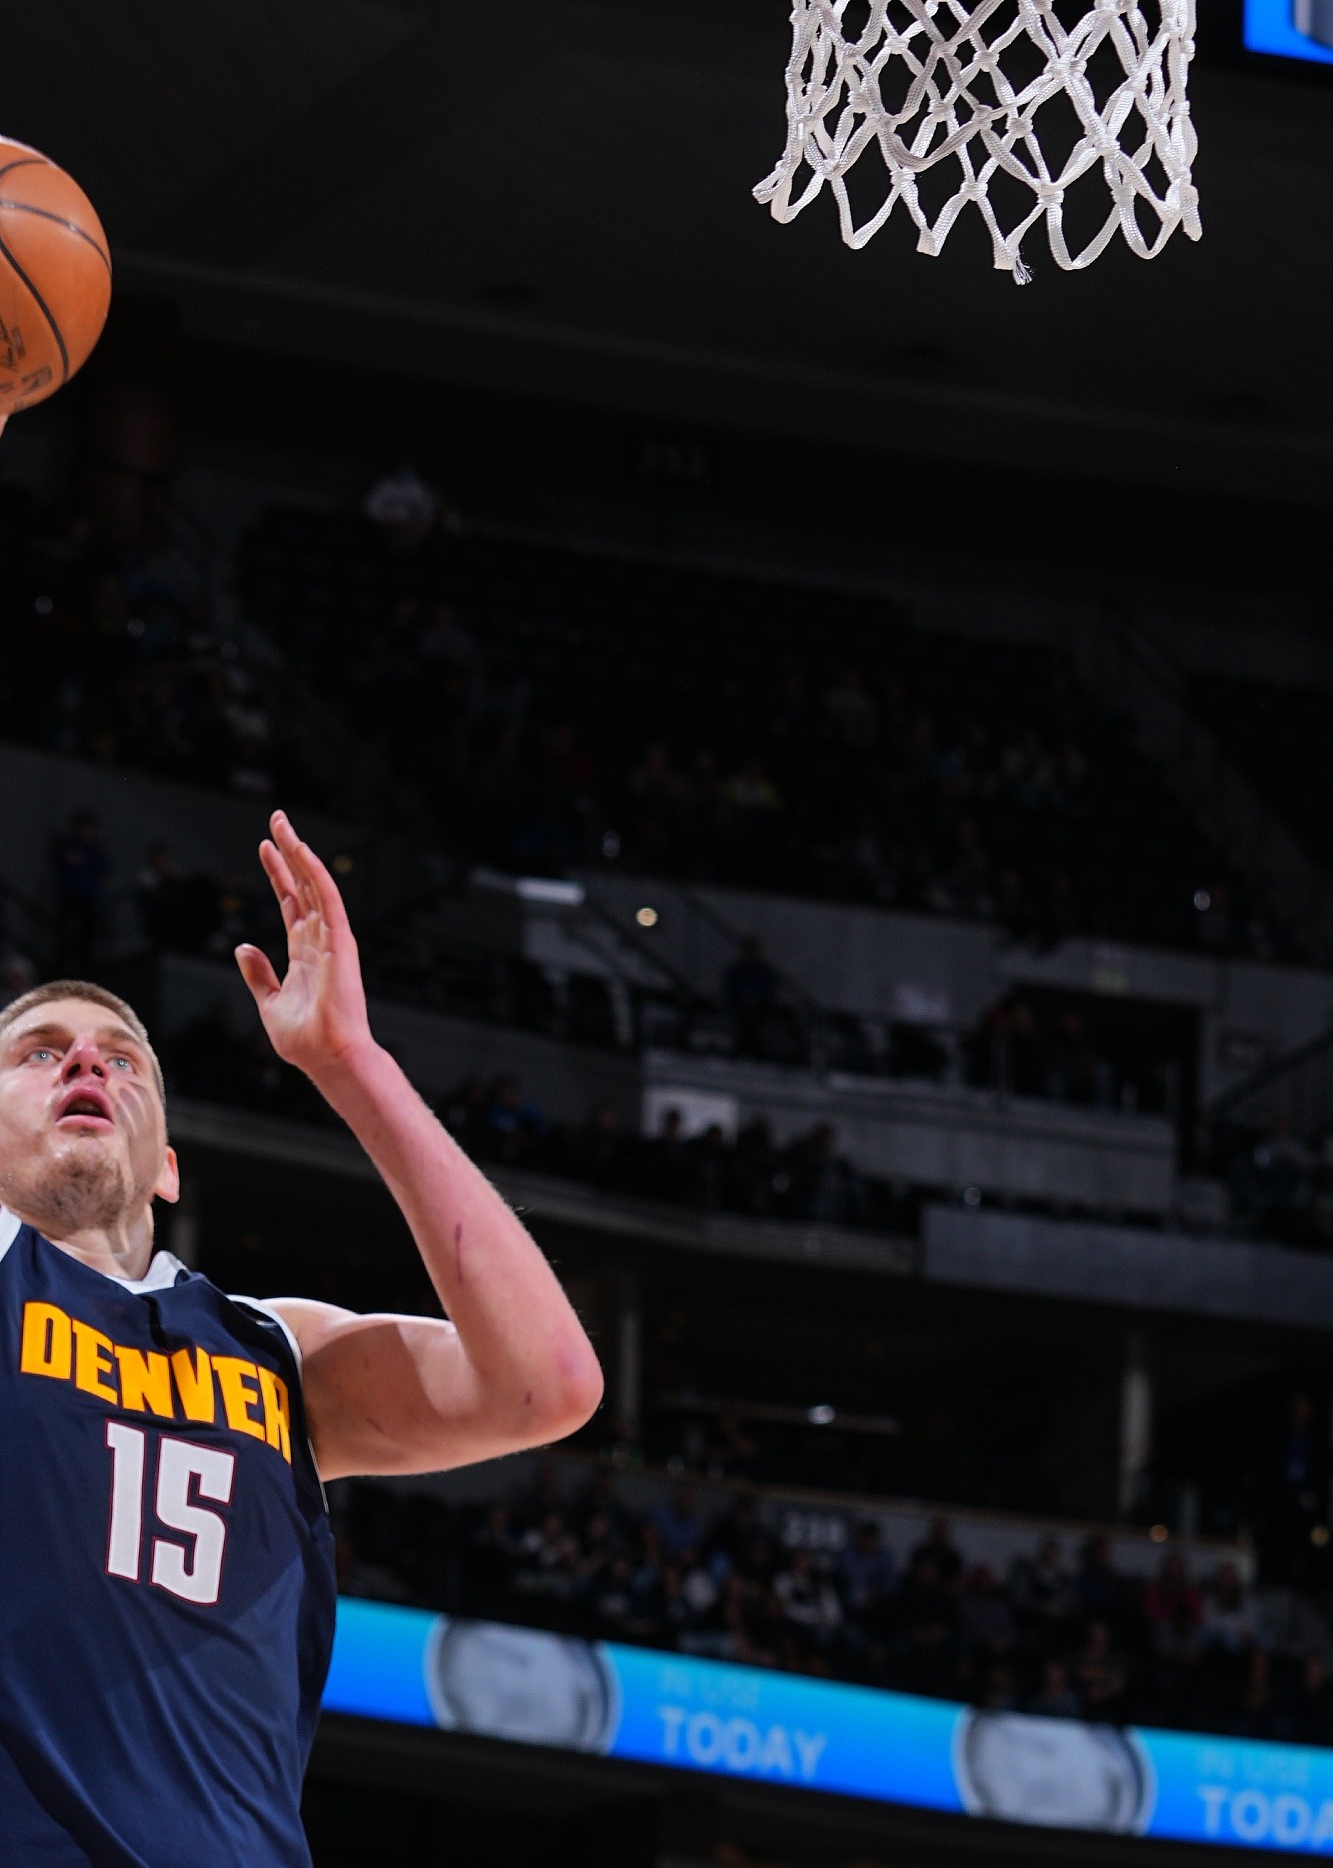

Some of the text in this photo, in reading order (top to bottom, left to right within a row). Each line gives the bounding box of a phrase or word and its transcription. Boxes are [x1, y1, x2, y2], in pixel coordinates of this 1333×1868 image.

[20, 1300, 292, 1466] DENVER
[104, 1417, 237, 1607] 15
[656, 1704, 827, 1782] TODAY
[1197, 1784, 1333, 1849] TODA
